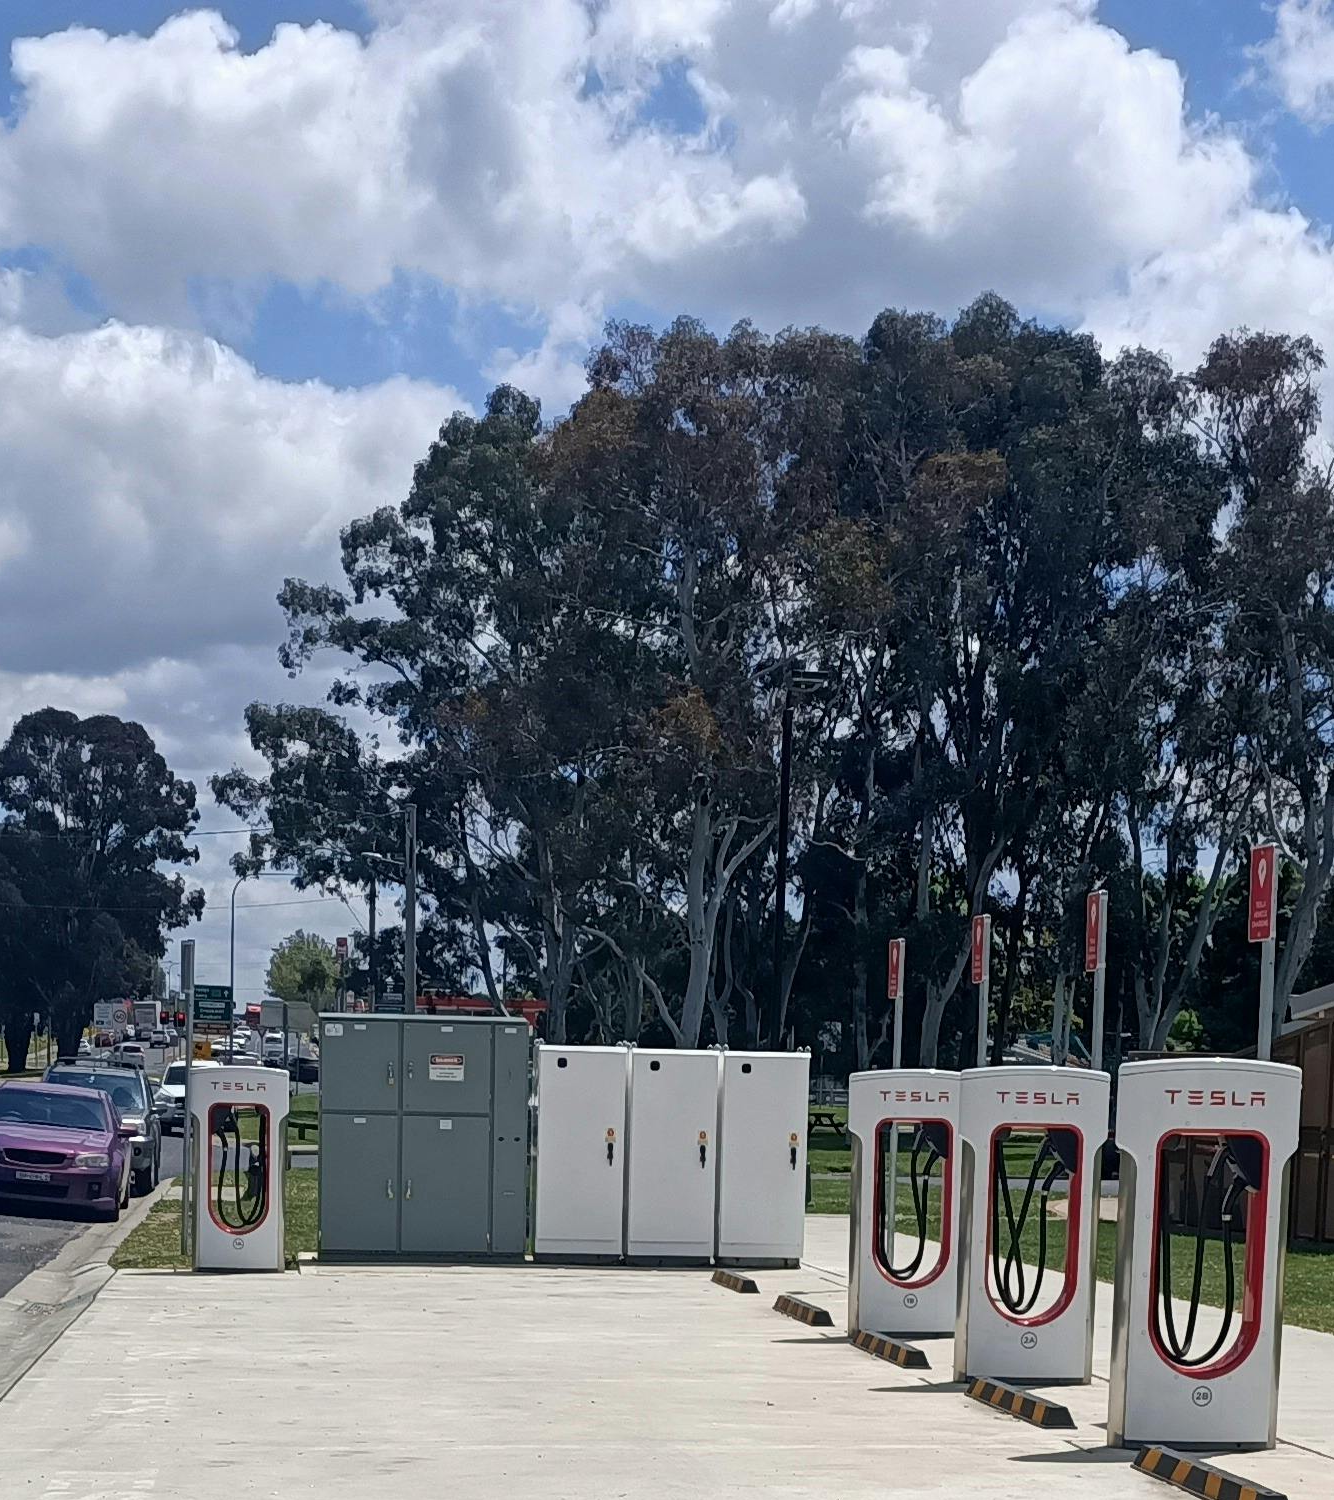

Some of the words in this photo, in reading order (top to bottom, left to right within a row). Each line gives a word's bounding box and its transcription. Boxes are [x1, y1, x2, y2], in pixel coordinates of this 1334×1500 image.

[210, 1081, 267, 1092] TESLA
[879, 1090, 950, 1103] TESLA
[996, 1091, 1080, 1105] TESLA
[1163, 1089, 1267, 1107] TESLA
[1195, 1391, 1209, 1401] 2B
